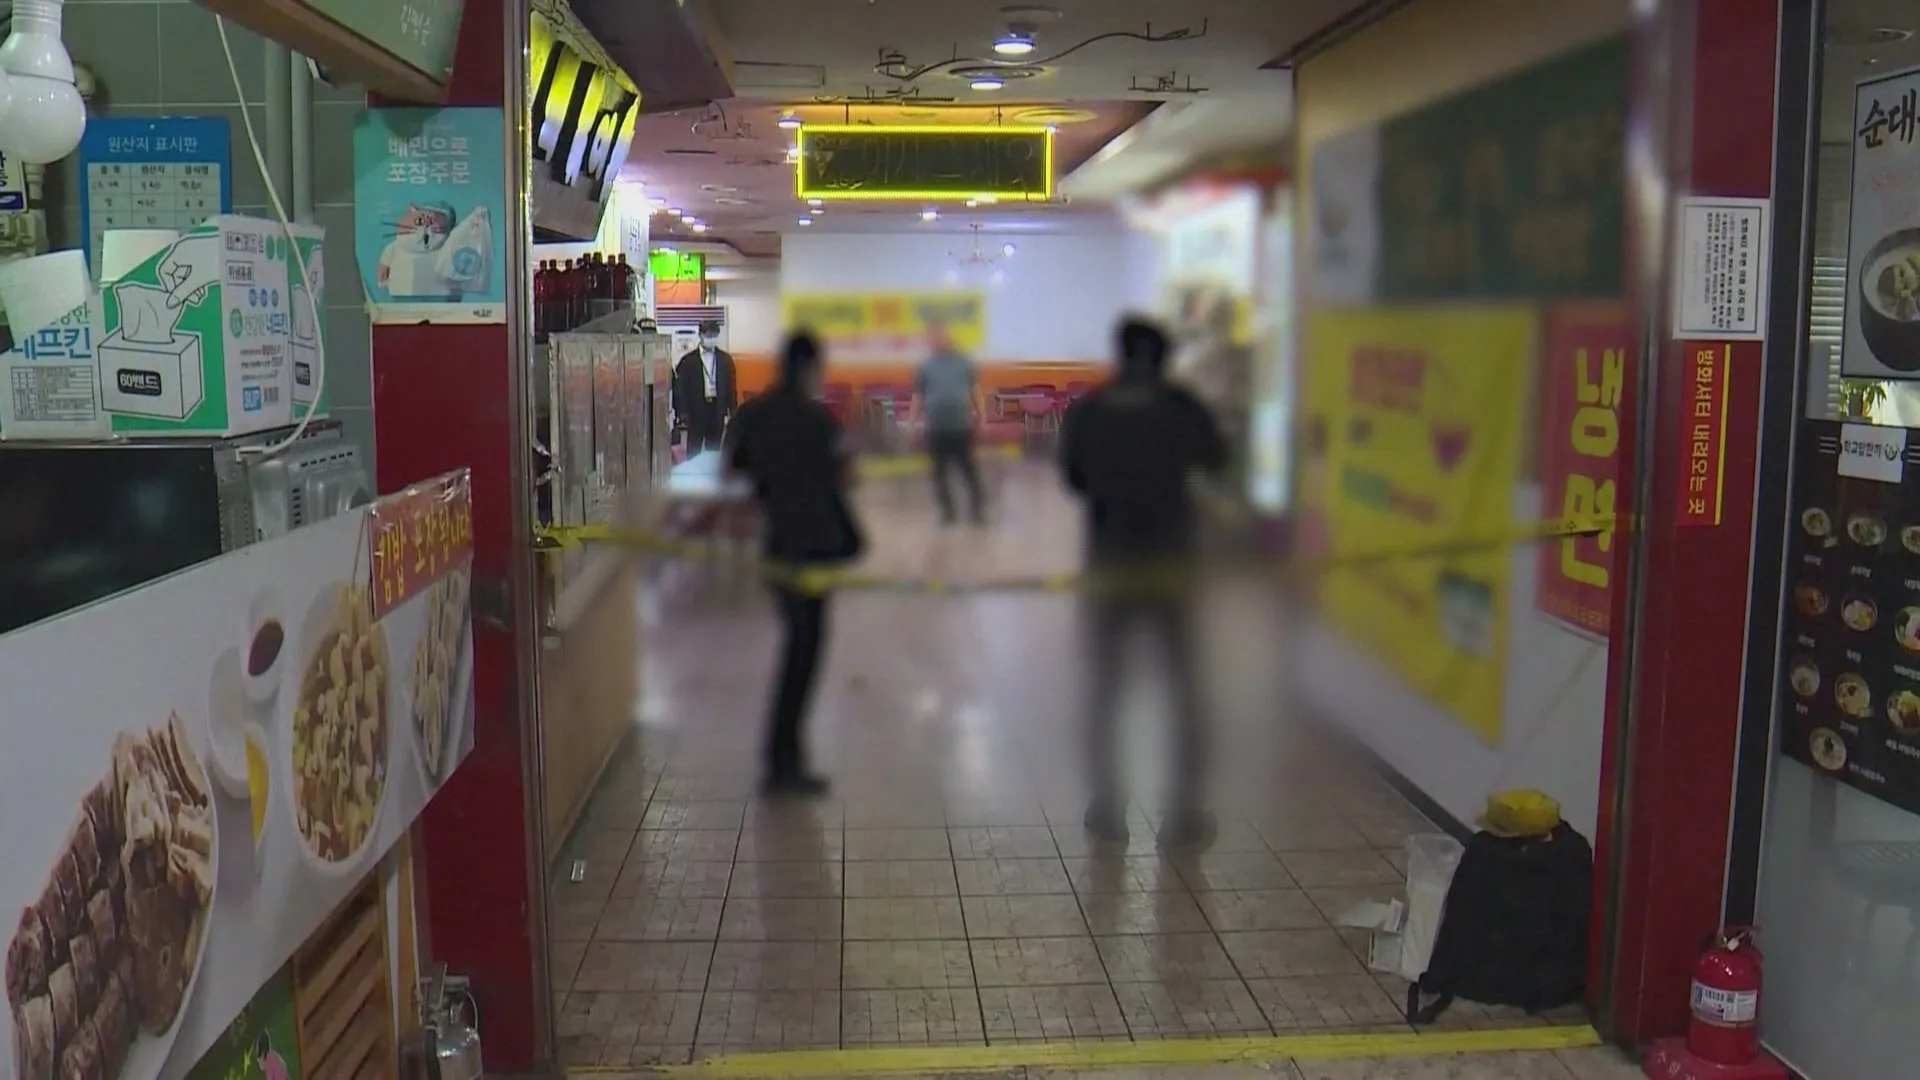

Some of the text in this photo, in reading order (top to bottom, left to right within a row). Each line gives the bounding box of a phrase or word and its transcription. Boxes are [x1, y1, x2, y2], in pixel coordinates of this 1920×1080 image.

[1859, 87, 1920, 149] 순대
[108, 136, 199, 153] 원산지 표시판
[388, 136, 470, 158] 배민으로
[387, 162, 470, 185] 포장주문
[1687, 350, 1715, 515] 방화셔터 내려오는 곳
[377, 518, 407, 605] 김밥
